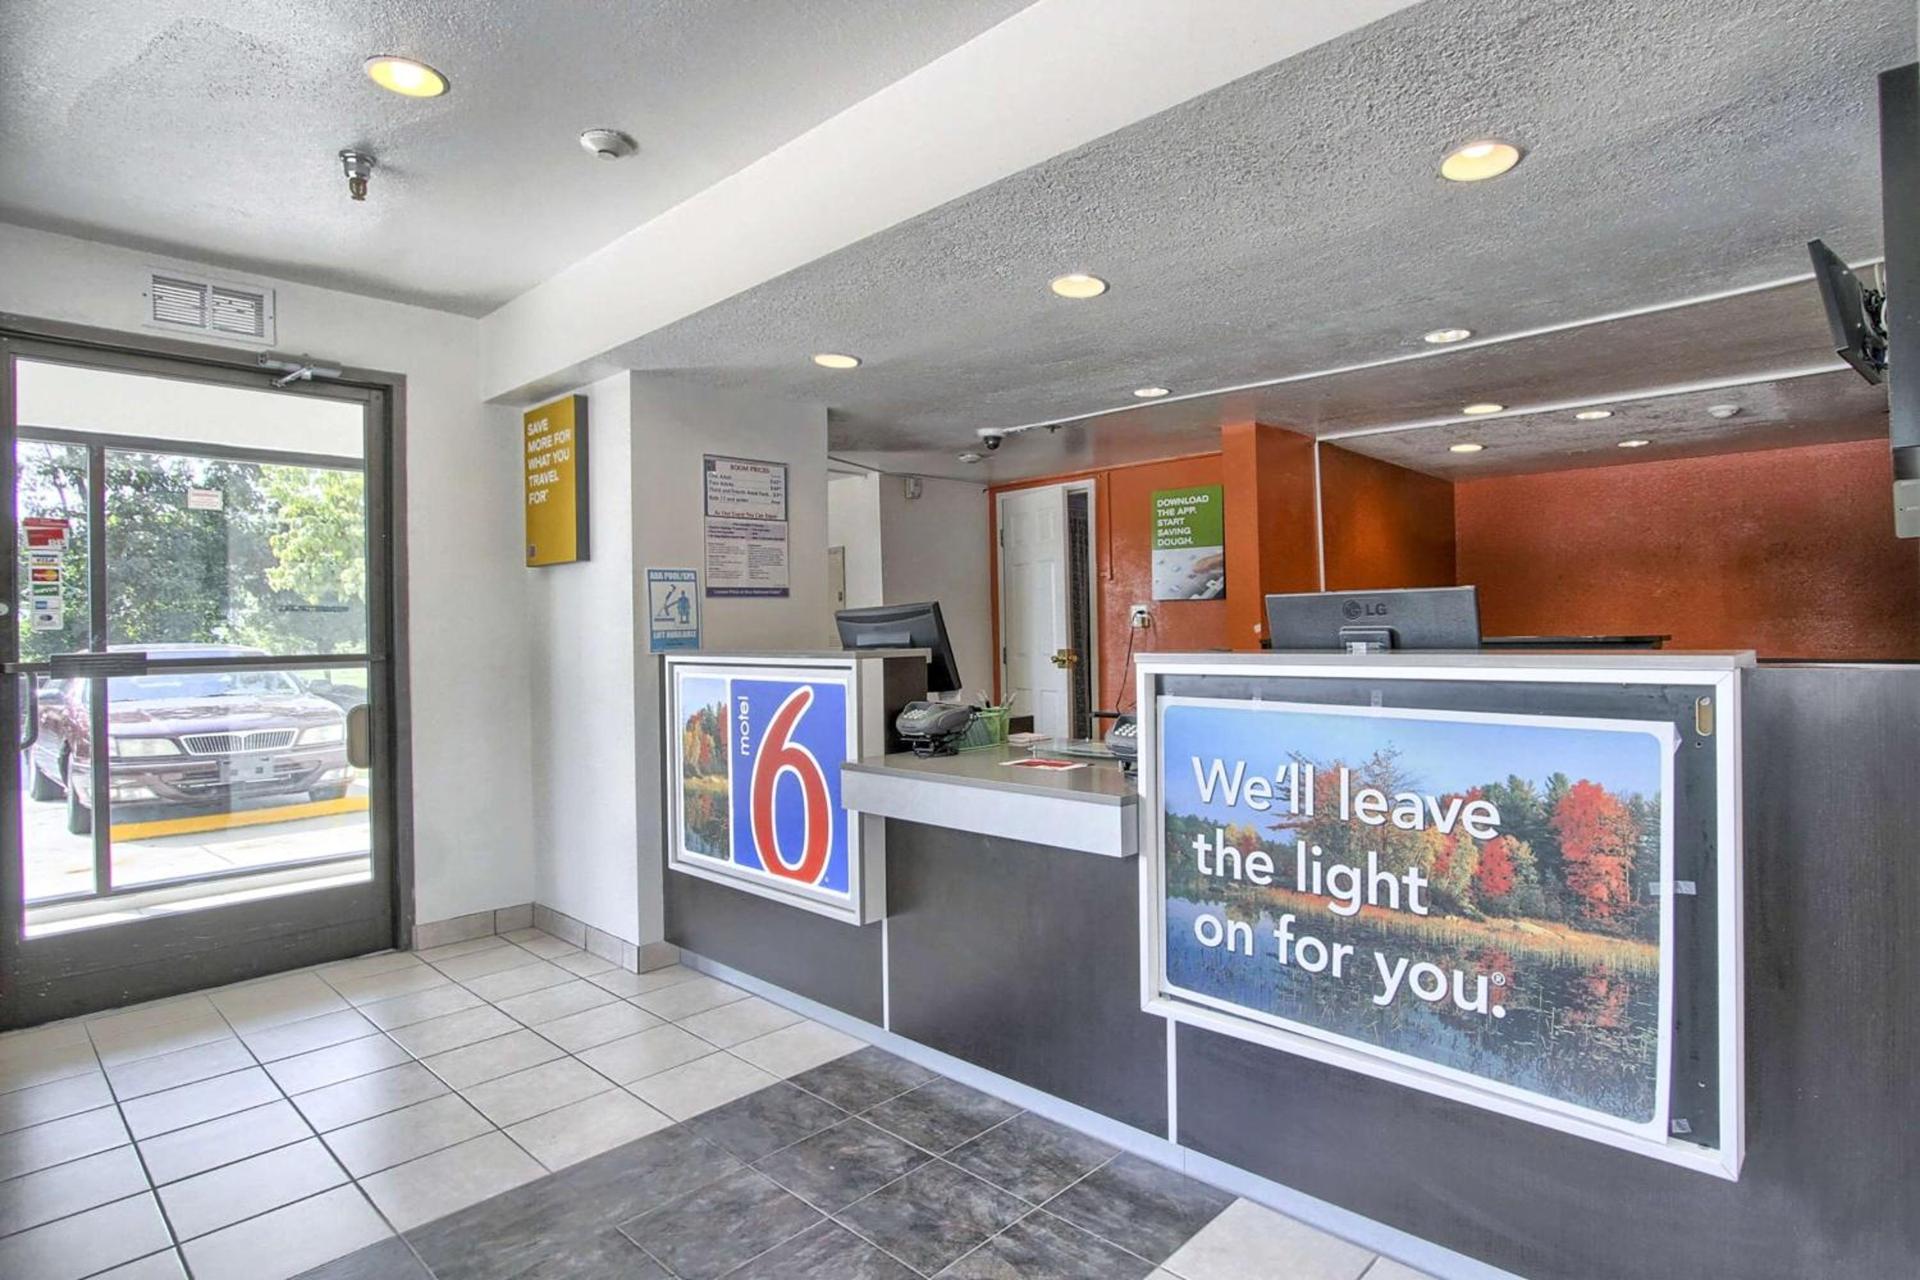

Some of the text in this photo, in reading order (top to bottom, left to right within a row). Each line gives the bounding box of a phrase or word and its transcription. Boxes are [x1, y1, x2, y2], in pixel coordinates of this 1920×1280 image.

[528, 418, 549, 436] SAVE
[528, 428, 571, 452] MORE FOR
[528, 447, 570, 470] WHAT YOU
[528, 470, 560, 487] TRAVEL
[749, 466, 770, 474] PRICES
[1157, 495, 1209, 508] DOWNLOAD
[1157, 506, 1198, 517] THE APP.
[1157, 517, 1185, 527] START
[1158, 527, 1191, 537] SAVING
[1158, 537, 1194, 546] DOUGH.
[1365, 603, 1387, 616] LG
[737, 696, 750, 756] motel
[750, 685, 833, 886] 6
[1192, 756, 1501, 840] We'll leave
[1192, 829, 1429, 917] the light
[1194, 913, 1253, 956] on
[1274, 914, 1354, 978] for
